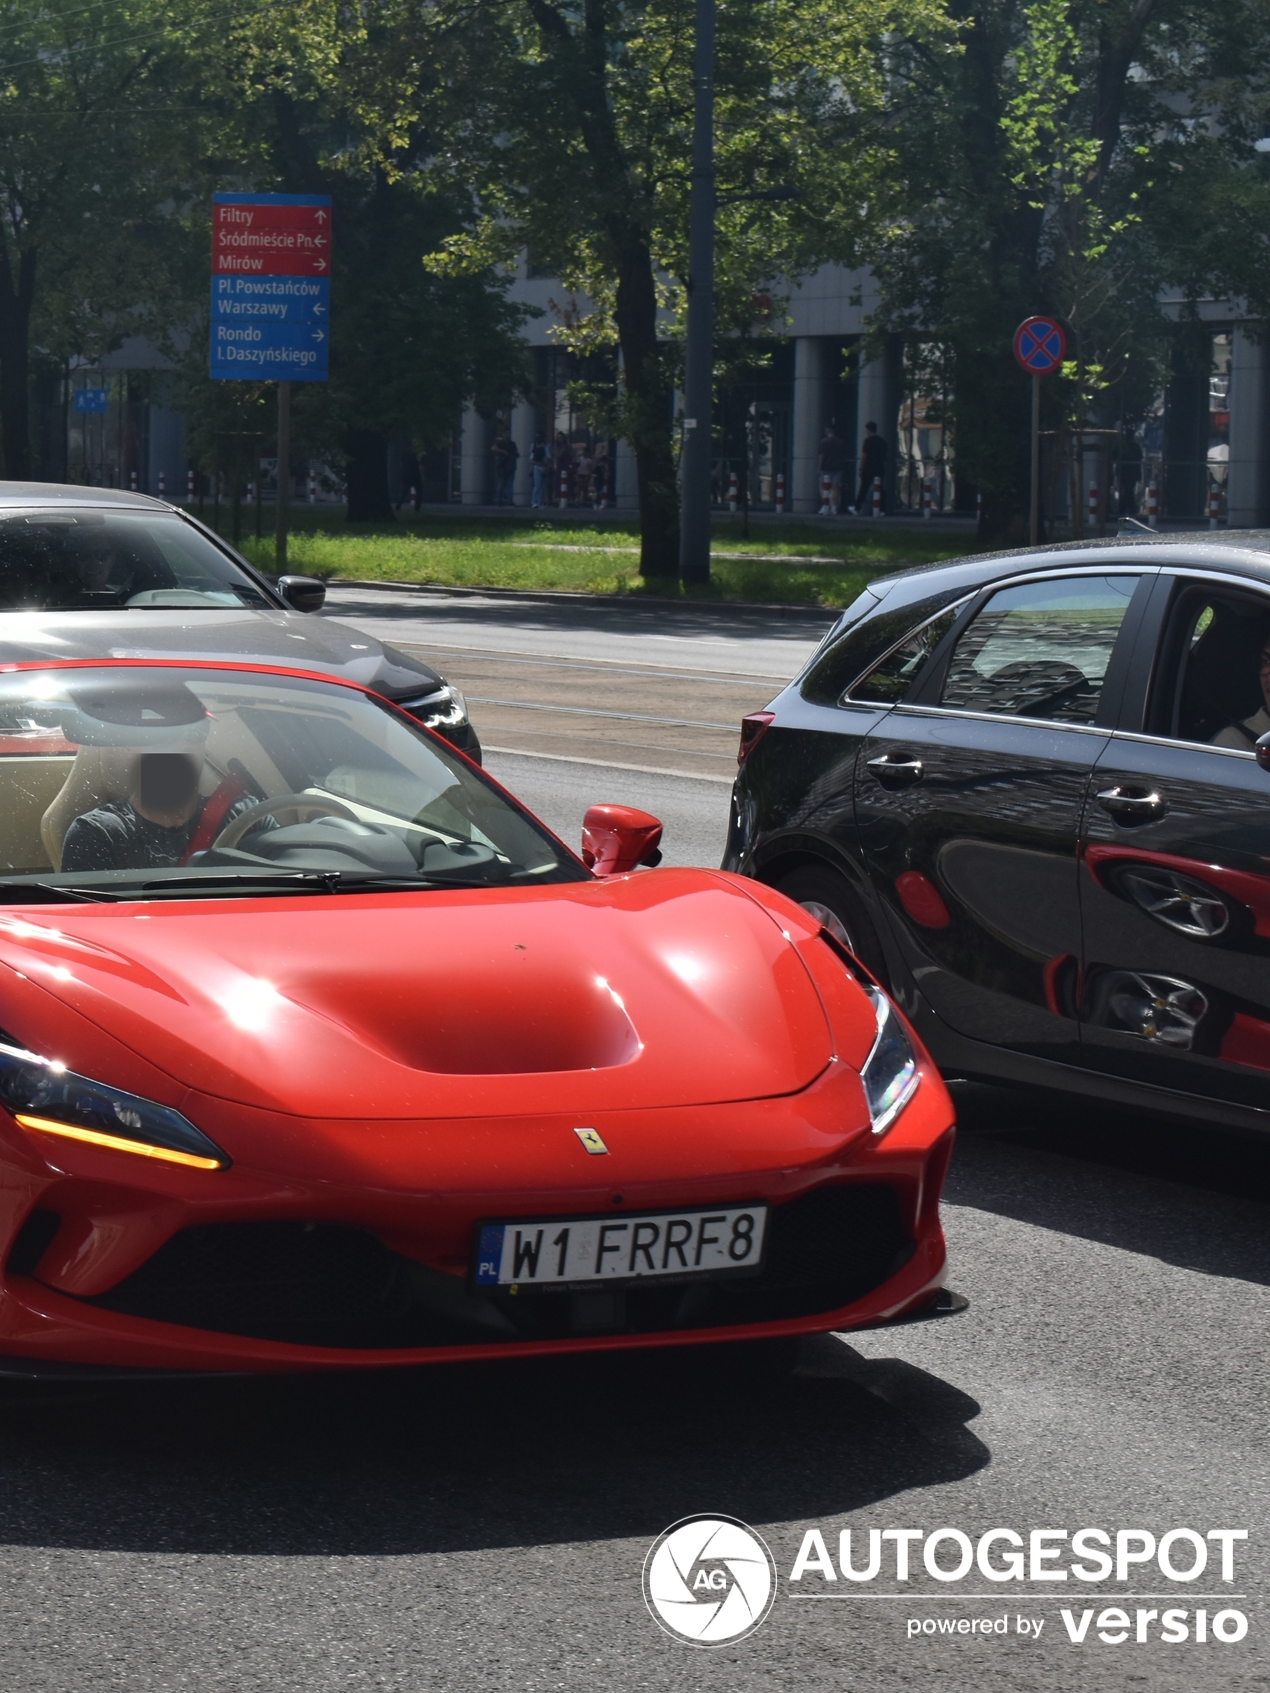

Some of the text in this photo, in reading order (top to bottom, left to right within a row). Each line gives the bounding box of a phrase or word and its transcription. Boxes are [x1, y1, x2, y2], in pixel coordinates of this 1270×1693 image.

[220, 208, 254, 227] Filtry
[219, 228, 315, 248] Śródmieście Pn.
[219, 255, 264, 270] Mirów
[218, 279, 320, 295] Pl. Powstańców
[218, 300, 288, 319] Warszawy
[218, 326, 261, 341] Rondo
[227, 346, 317, 366] Daszyńskiego
[513, 1213, 755, 1279] W1 FRRF8
[479, 1262, 497, 1276] PL
